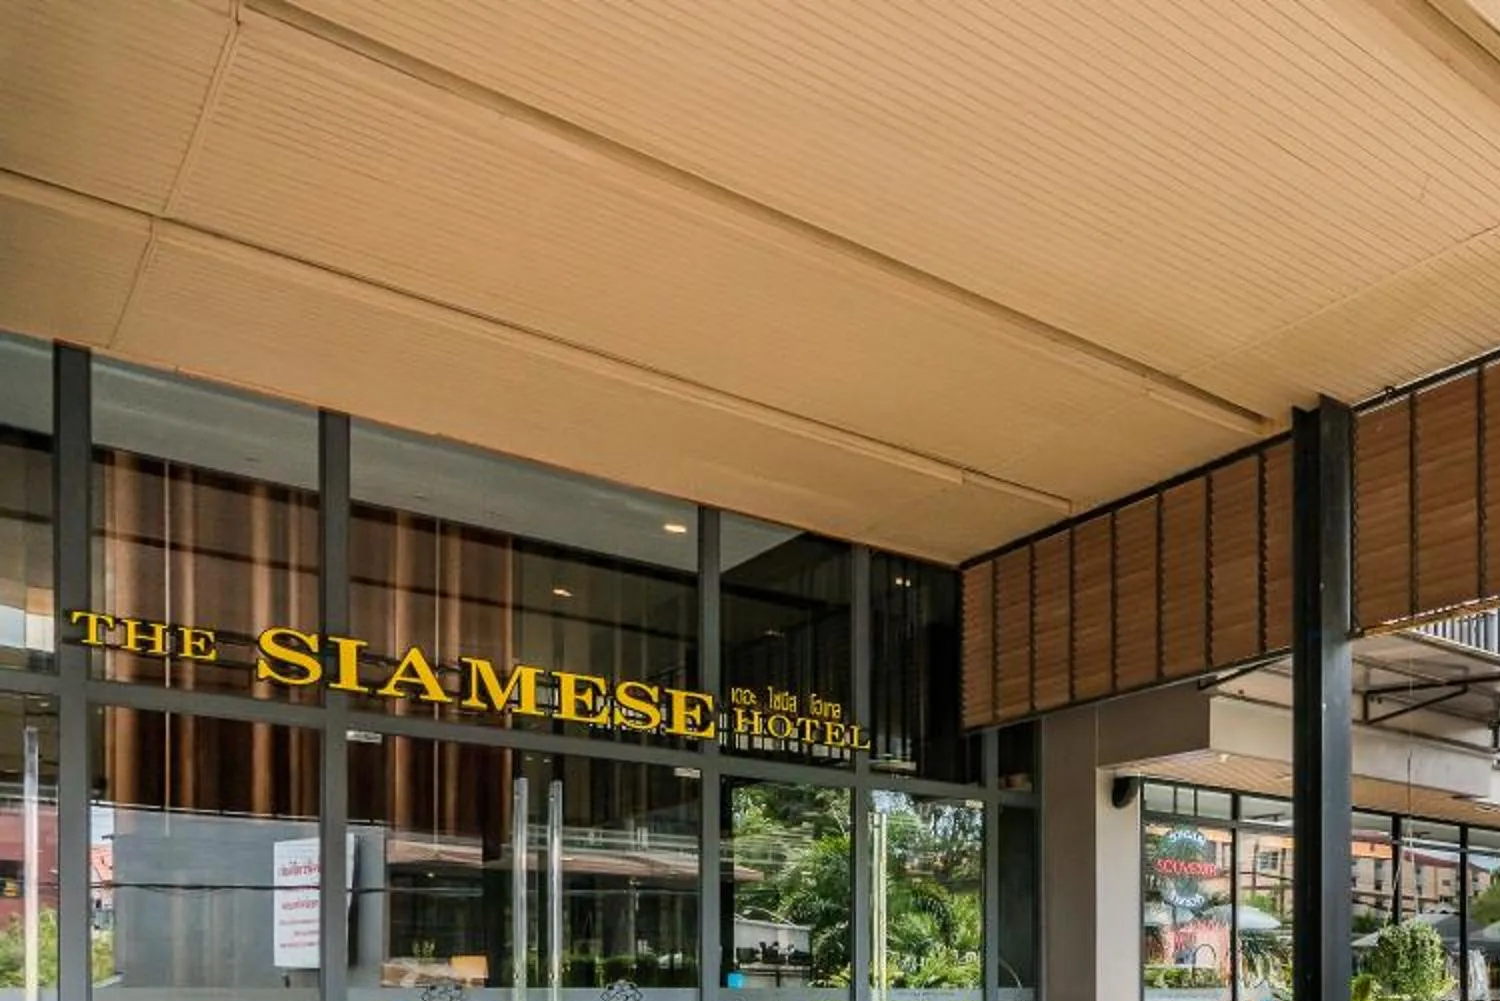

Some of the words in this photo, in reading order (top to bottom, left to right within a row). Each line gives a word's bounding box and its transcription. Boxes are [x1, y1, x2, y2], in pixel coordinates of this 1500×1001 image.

[71, 611, 217, 661] THE
[257, 626, 716, 740] SIAMESE
[733, 707, 871, 749] HOTEL
